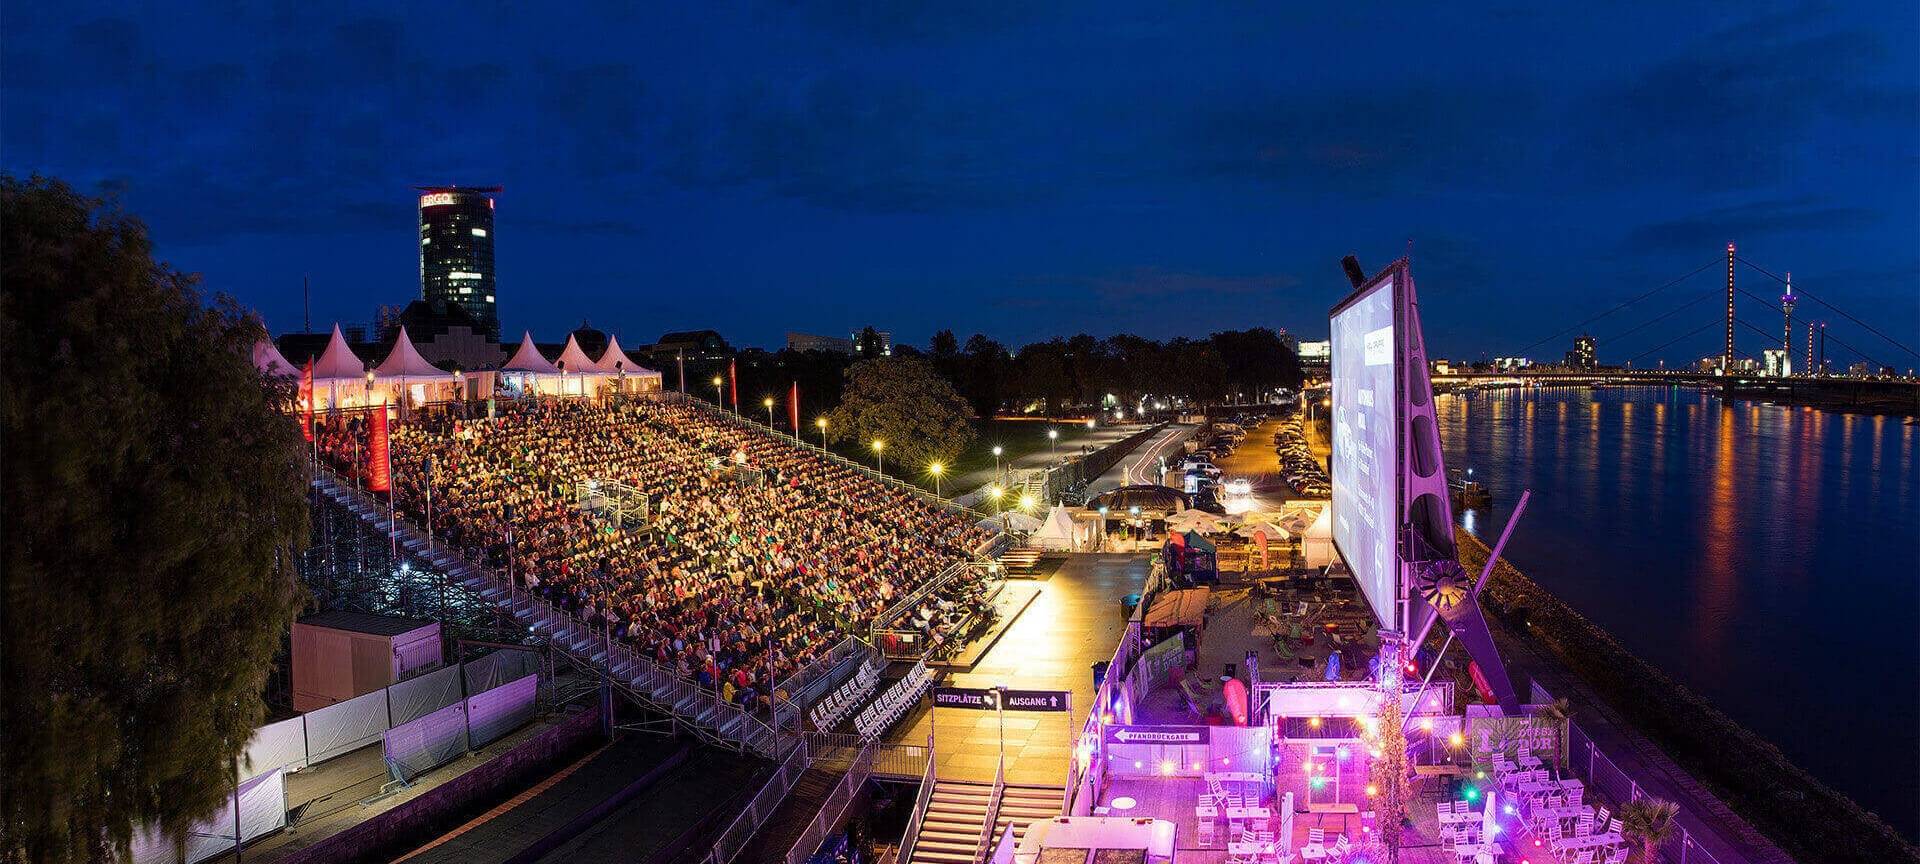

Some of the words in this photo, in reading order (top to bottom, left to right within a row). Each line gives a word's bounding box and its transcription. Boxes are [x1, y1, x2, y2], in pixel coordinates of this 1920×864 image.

[422, 192, 449, 205] ERGO
[936, 693, 982, 705] SITZPLÄTZE
[1009, 697, 1047, 706] AUSGANG
